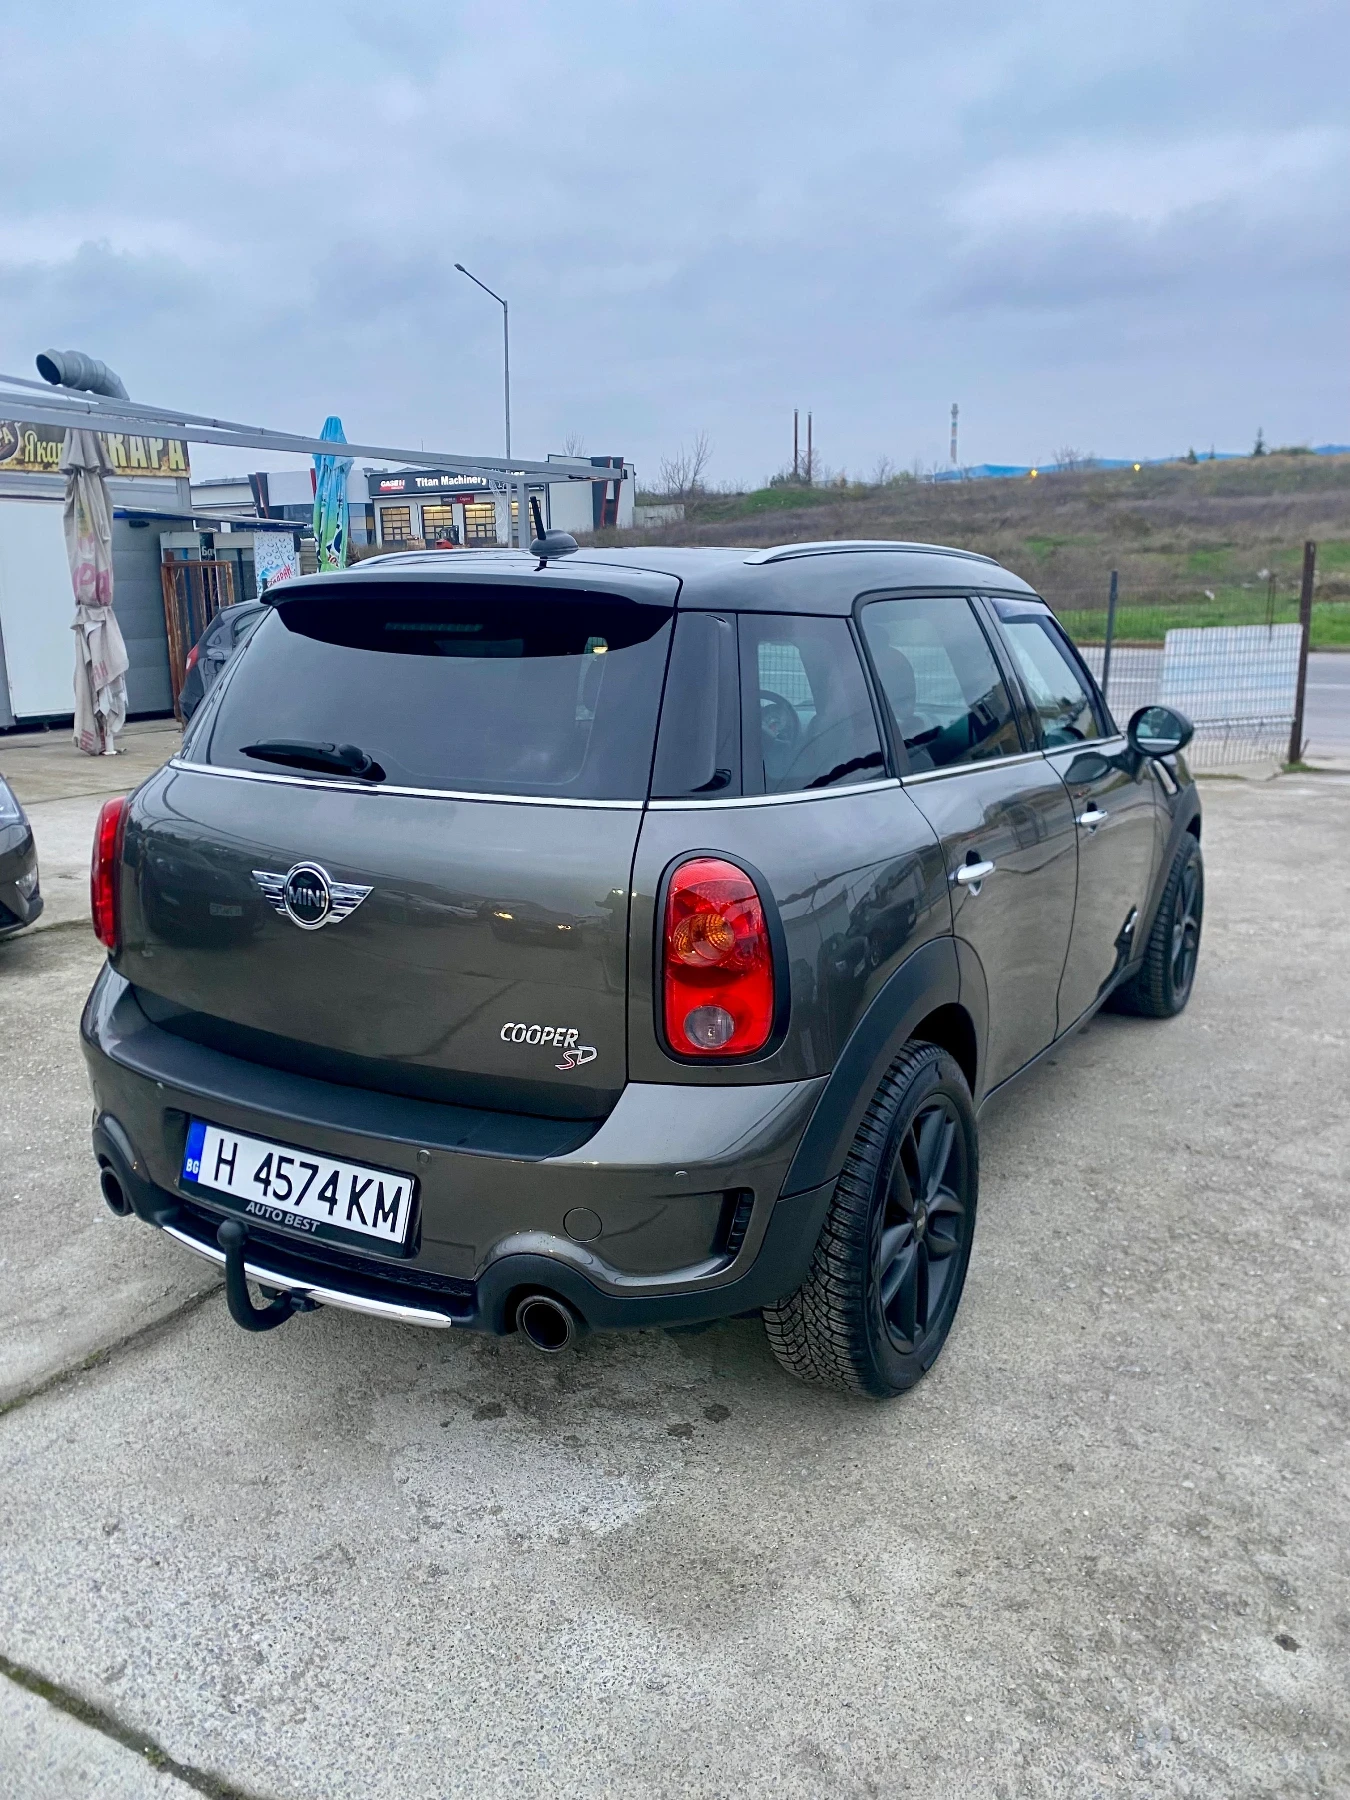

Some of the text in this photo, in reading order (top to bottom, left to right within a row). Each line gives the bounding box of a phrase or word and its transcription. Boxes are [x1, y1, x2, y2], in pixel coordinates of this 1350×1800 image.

[415, 475, 487, 487] Titan Machinery
[288, 885, 326, 908] MINI
[500, 1022, 579, 1048] COOPER
[555, 1045, 598, 1070] SD
[186, 1158, 200, 1174] BG
[213, 1138, 238, 1186] H
[246, 1201, 320, 1233] AUTO BEST
